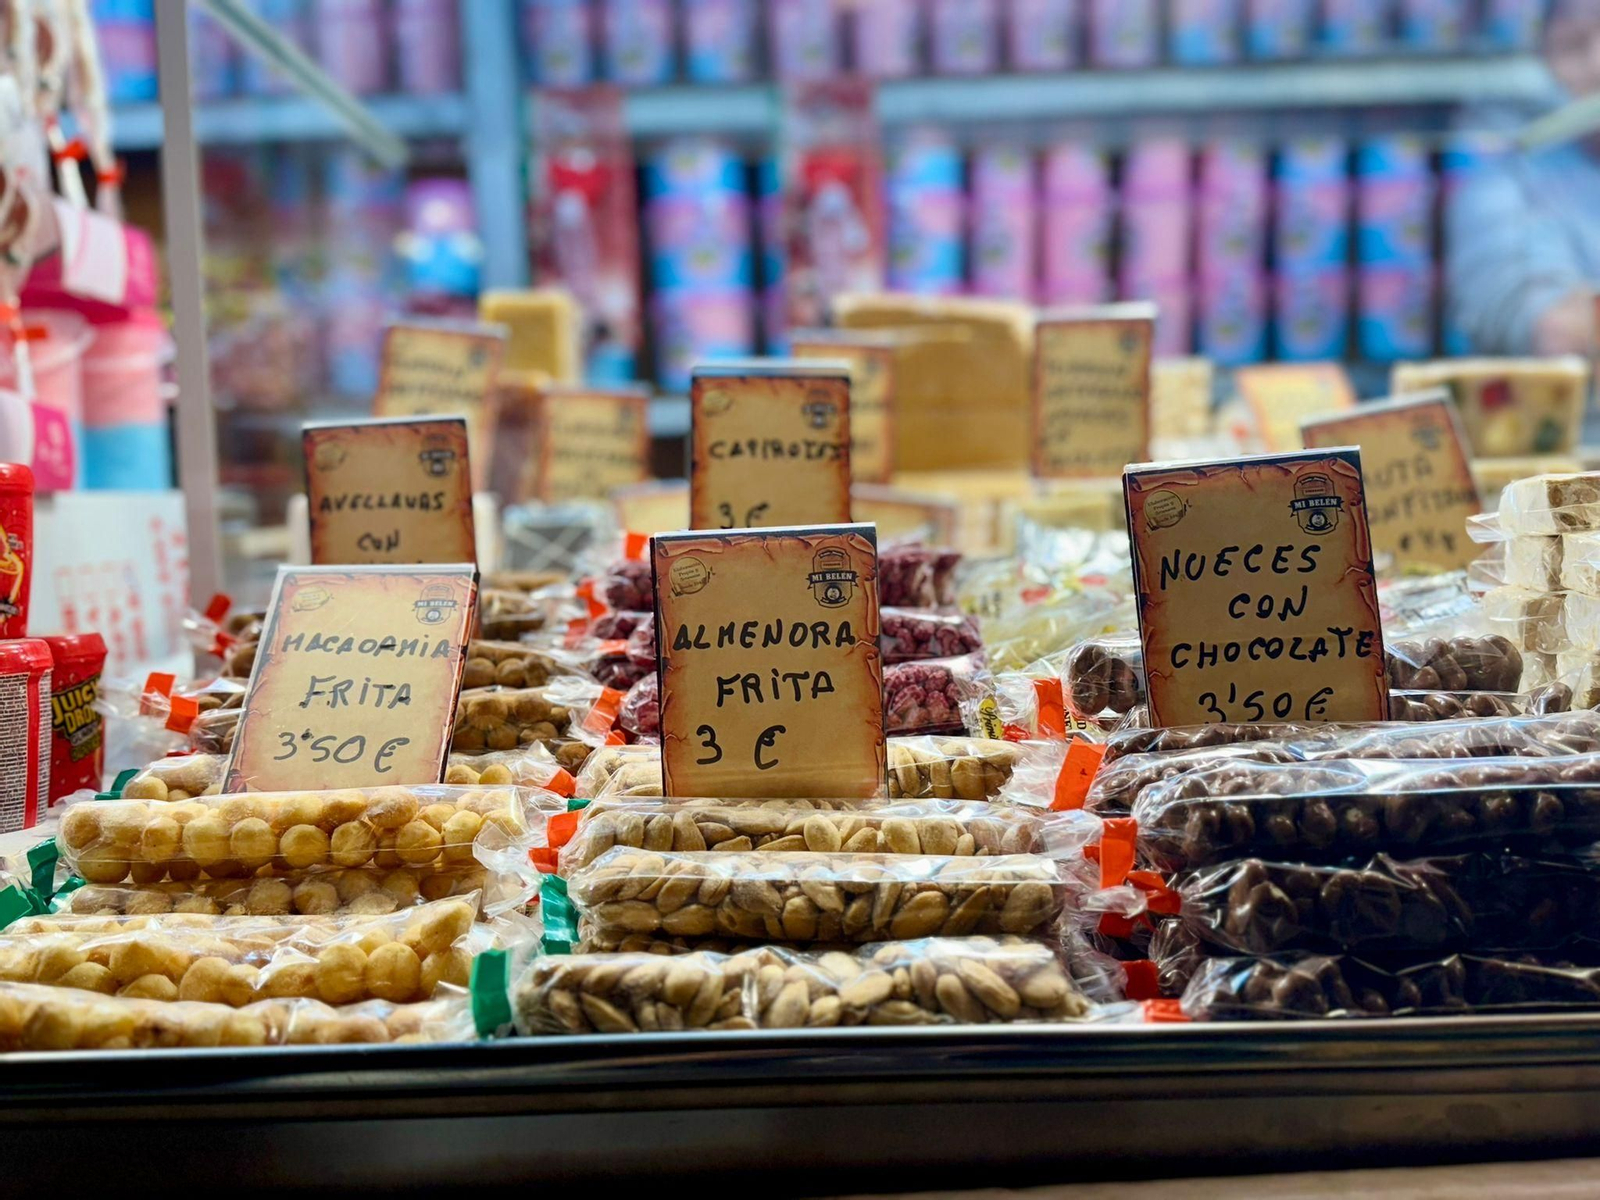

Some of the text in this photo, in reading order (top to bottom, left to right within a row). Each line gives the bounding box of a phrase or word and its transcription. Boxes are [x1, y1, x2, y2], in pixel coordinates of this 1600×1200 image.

[1294, 501, 1306, 509] MI
[812, 574, 823, 582] MI
[1160, 544, 1321, 591] NUECES
[1228, 585, 1308, 621] CON
[696, 724, 722, 764] 3
